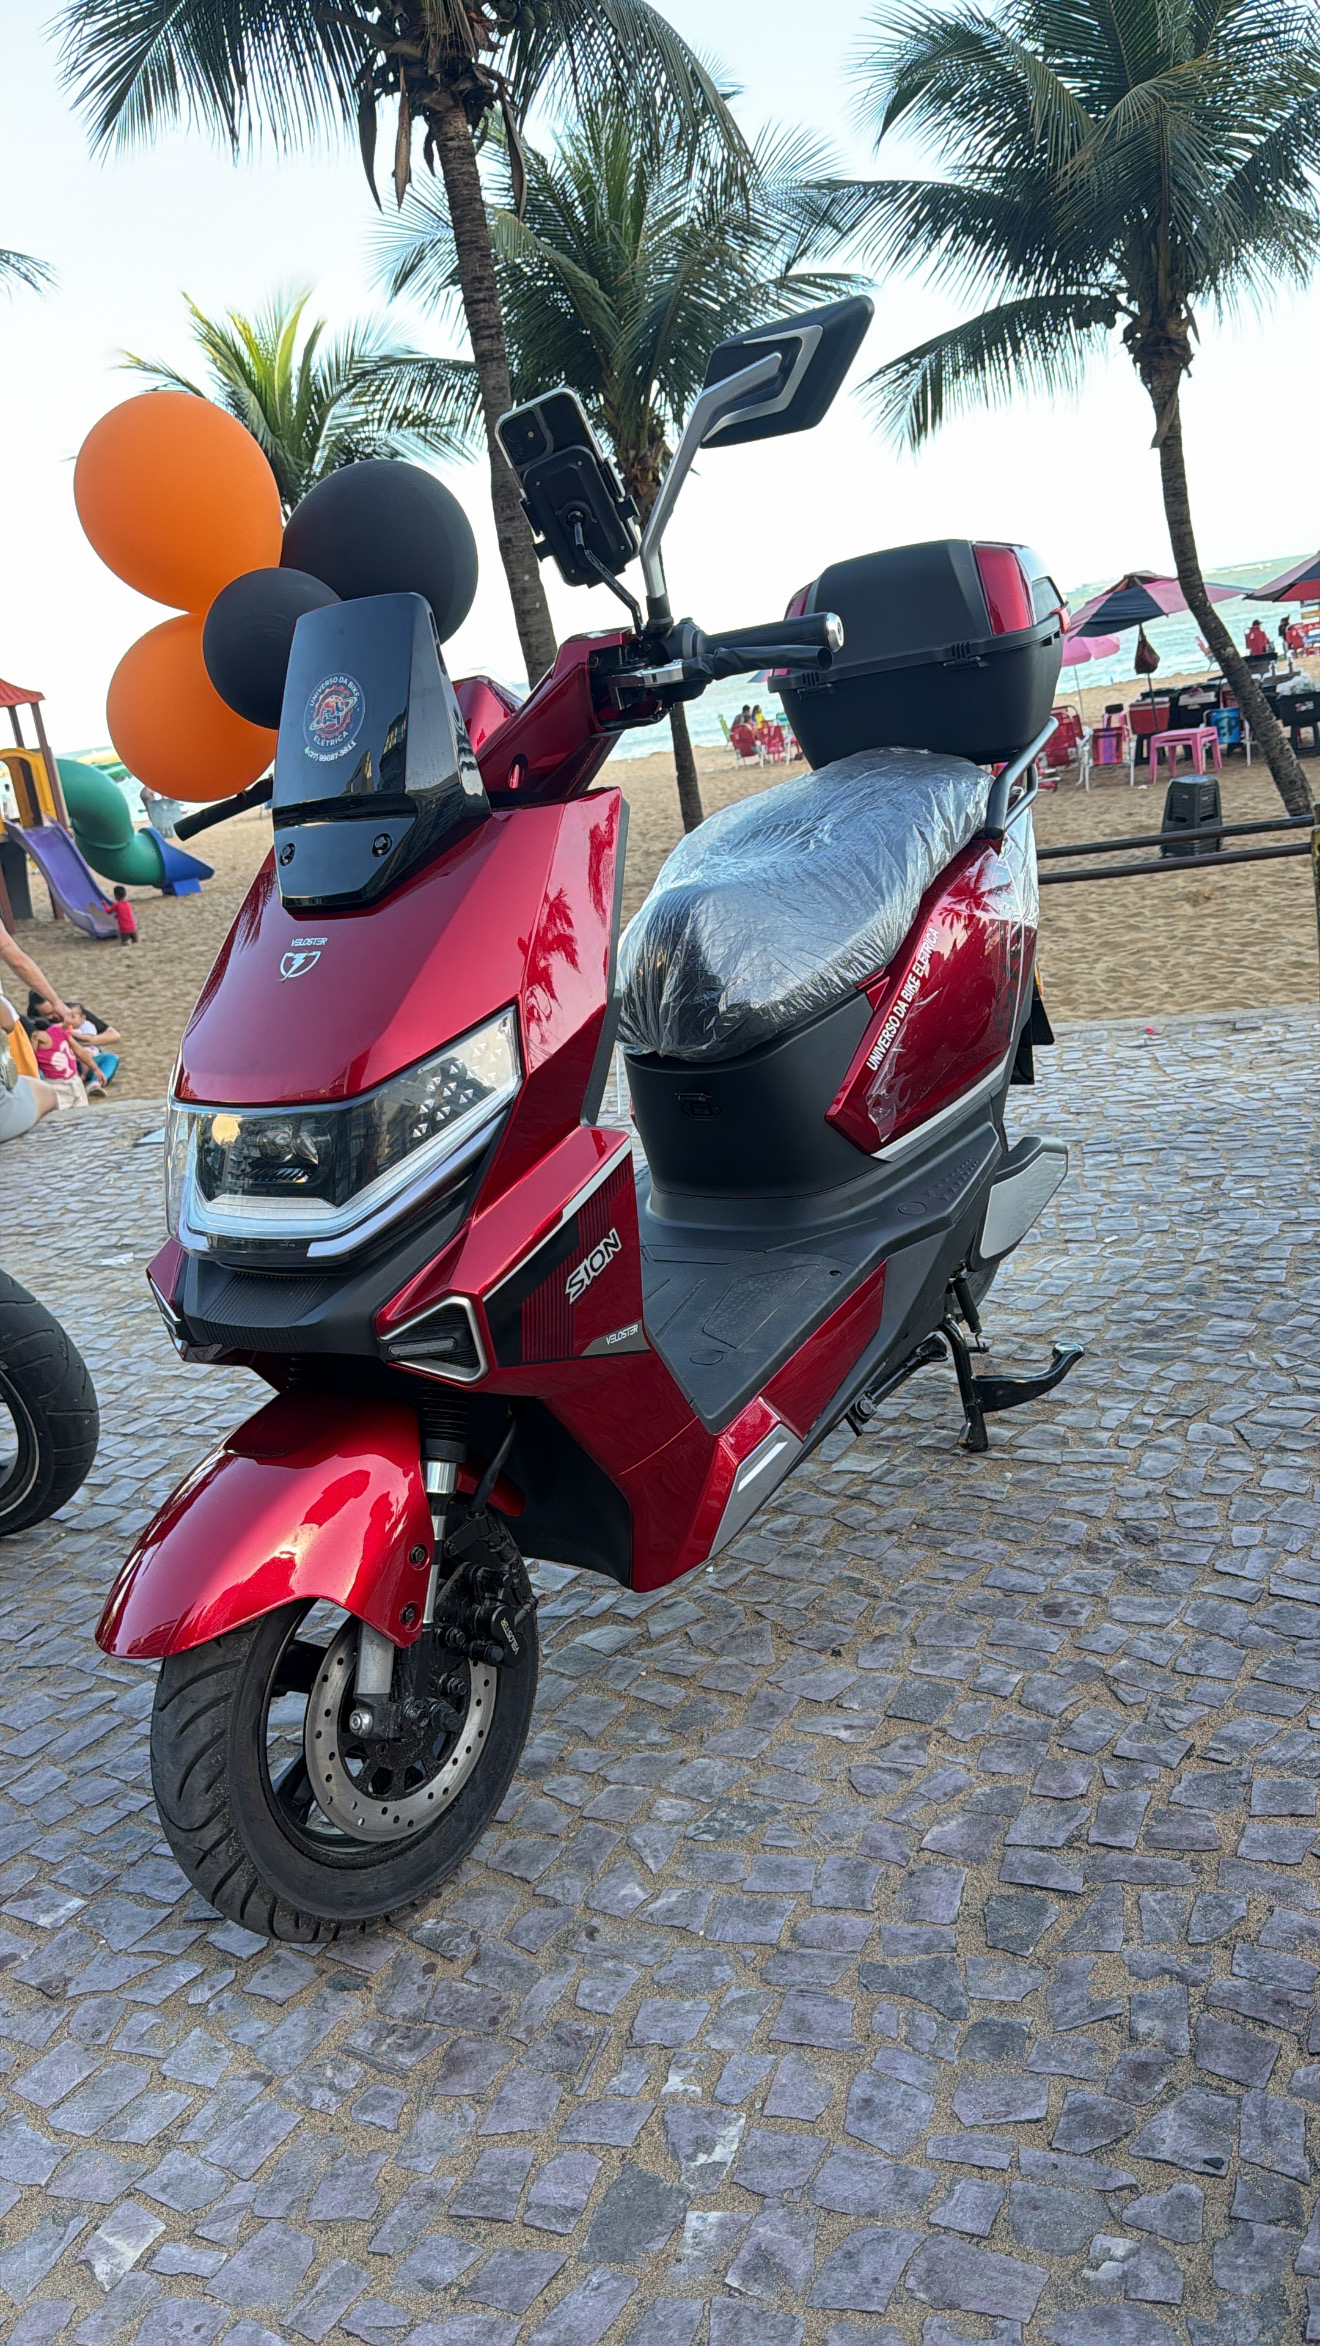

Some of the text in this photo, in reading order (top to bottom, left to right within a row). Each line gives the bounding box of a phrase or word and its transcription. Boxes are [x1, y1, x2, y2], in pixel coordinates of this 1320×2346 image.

[309, 676, 360, 707] UNIVERSO DA BIKE
[290, 937, 328, 947] VELOSTER
[866, 1016, 900, 1071] UNIVERSO
[893, 1000, 909, 1019] DA
[901, 973, 920, 1002] BIKE
[565, 1227, 622, 1305] SION
[605, 1324, 639, 1345] VELOSTER
[500, 1617, 520, 1655] VELOSTER
